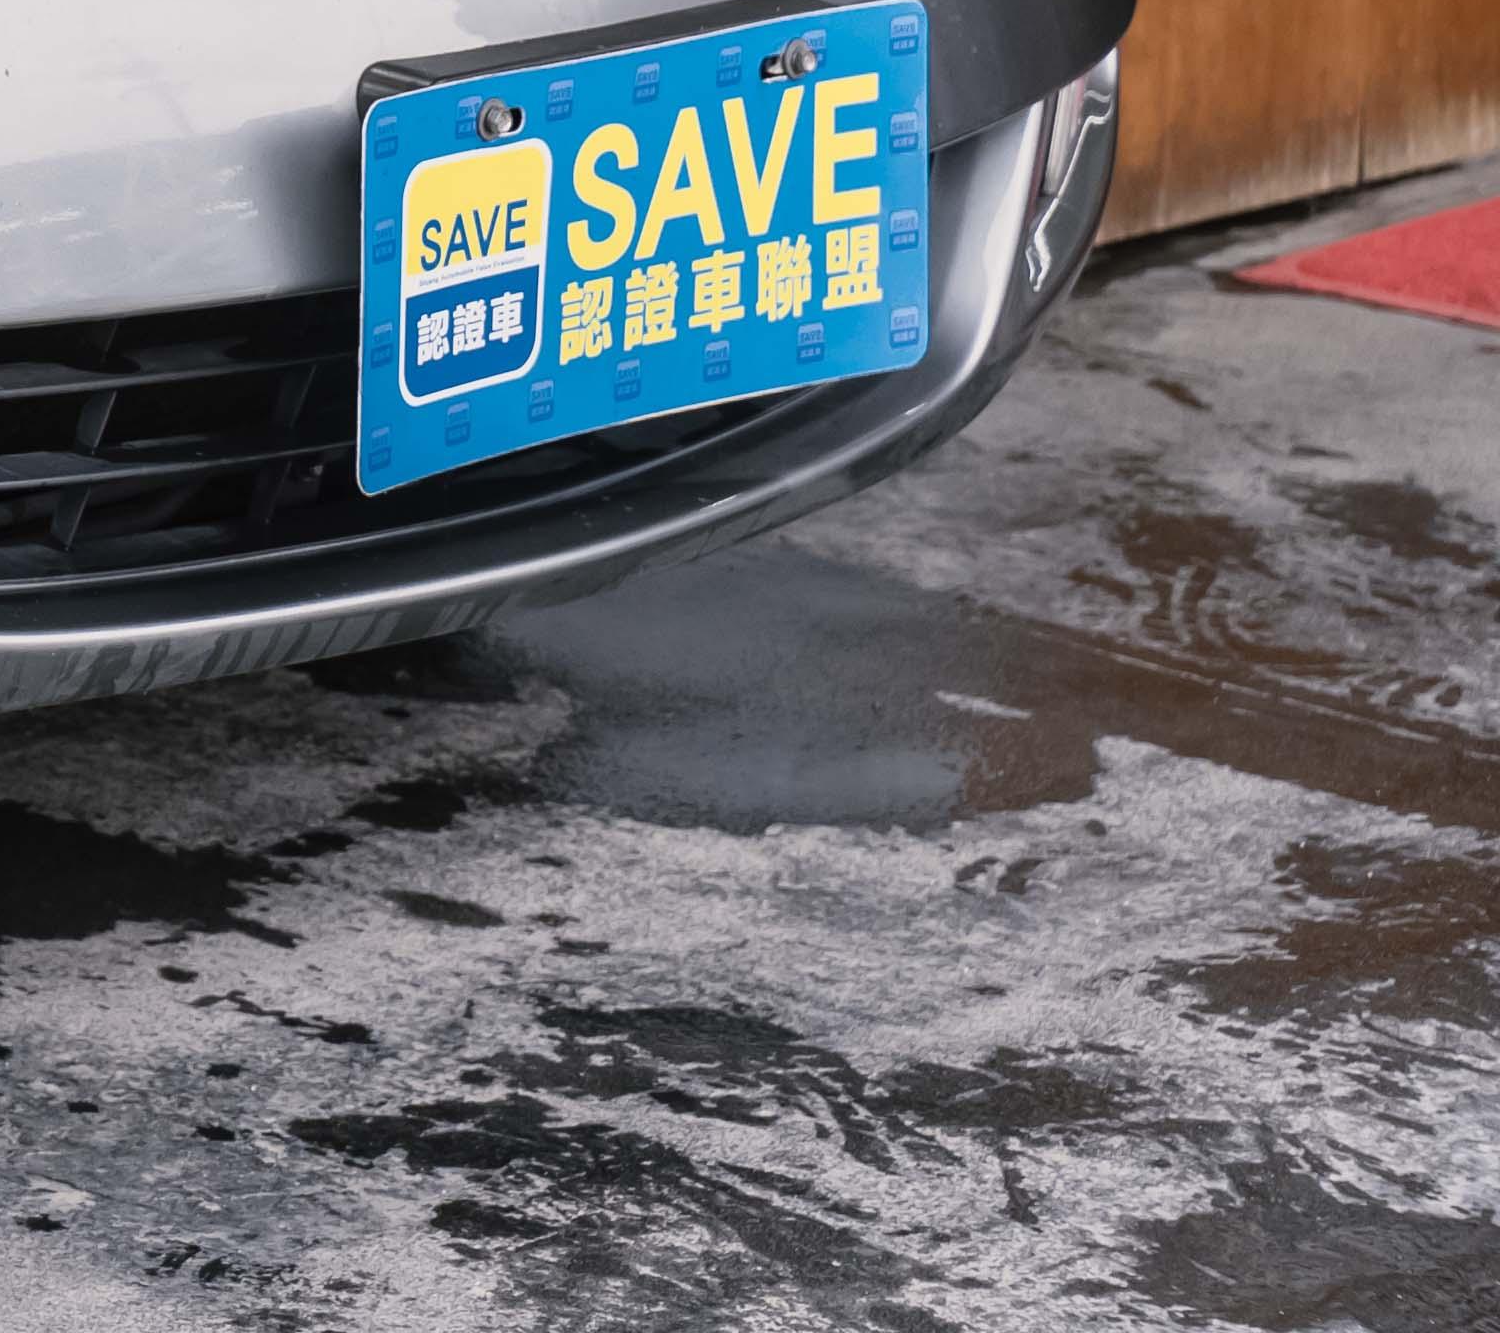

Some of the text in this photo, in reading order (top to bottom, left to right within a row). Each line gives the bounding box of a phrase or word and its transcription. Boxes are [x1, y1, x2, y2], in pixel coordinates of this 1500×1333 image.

[566, 71, 881, 271] SAVE
[420, 198, 528, 272] SAVE
[416, 290, 524, 366] 認證車
[558, 223, 883, 366] 認證車聯盟
